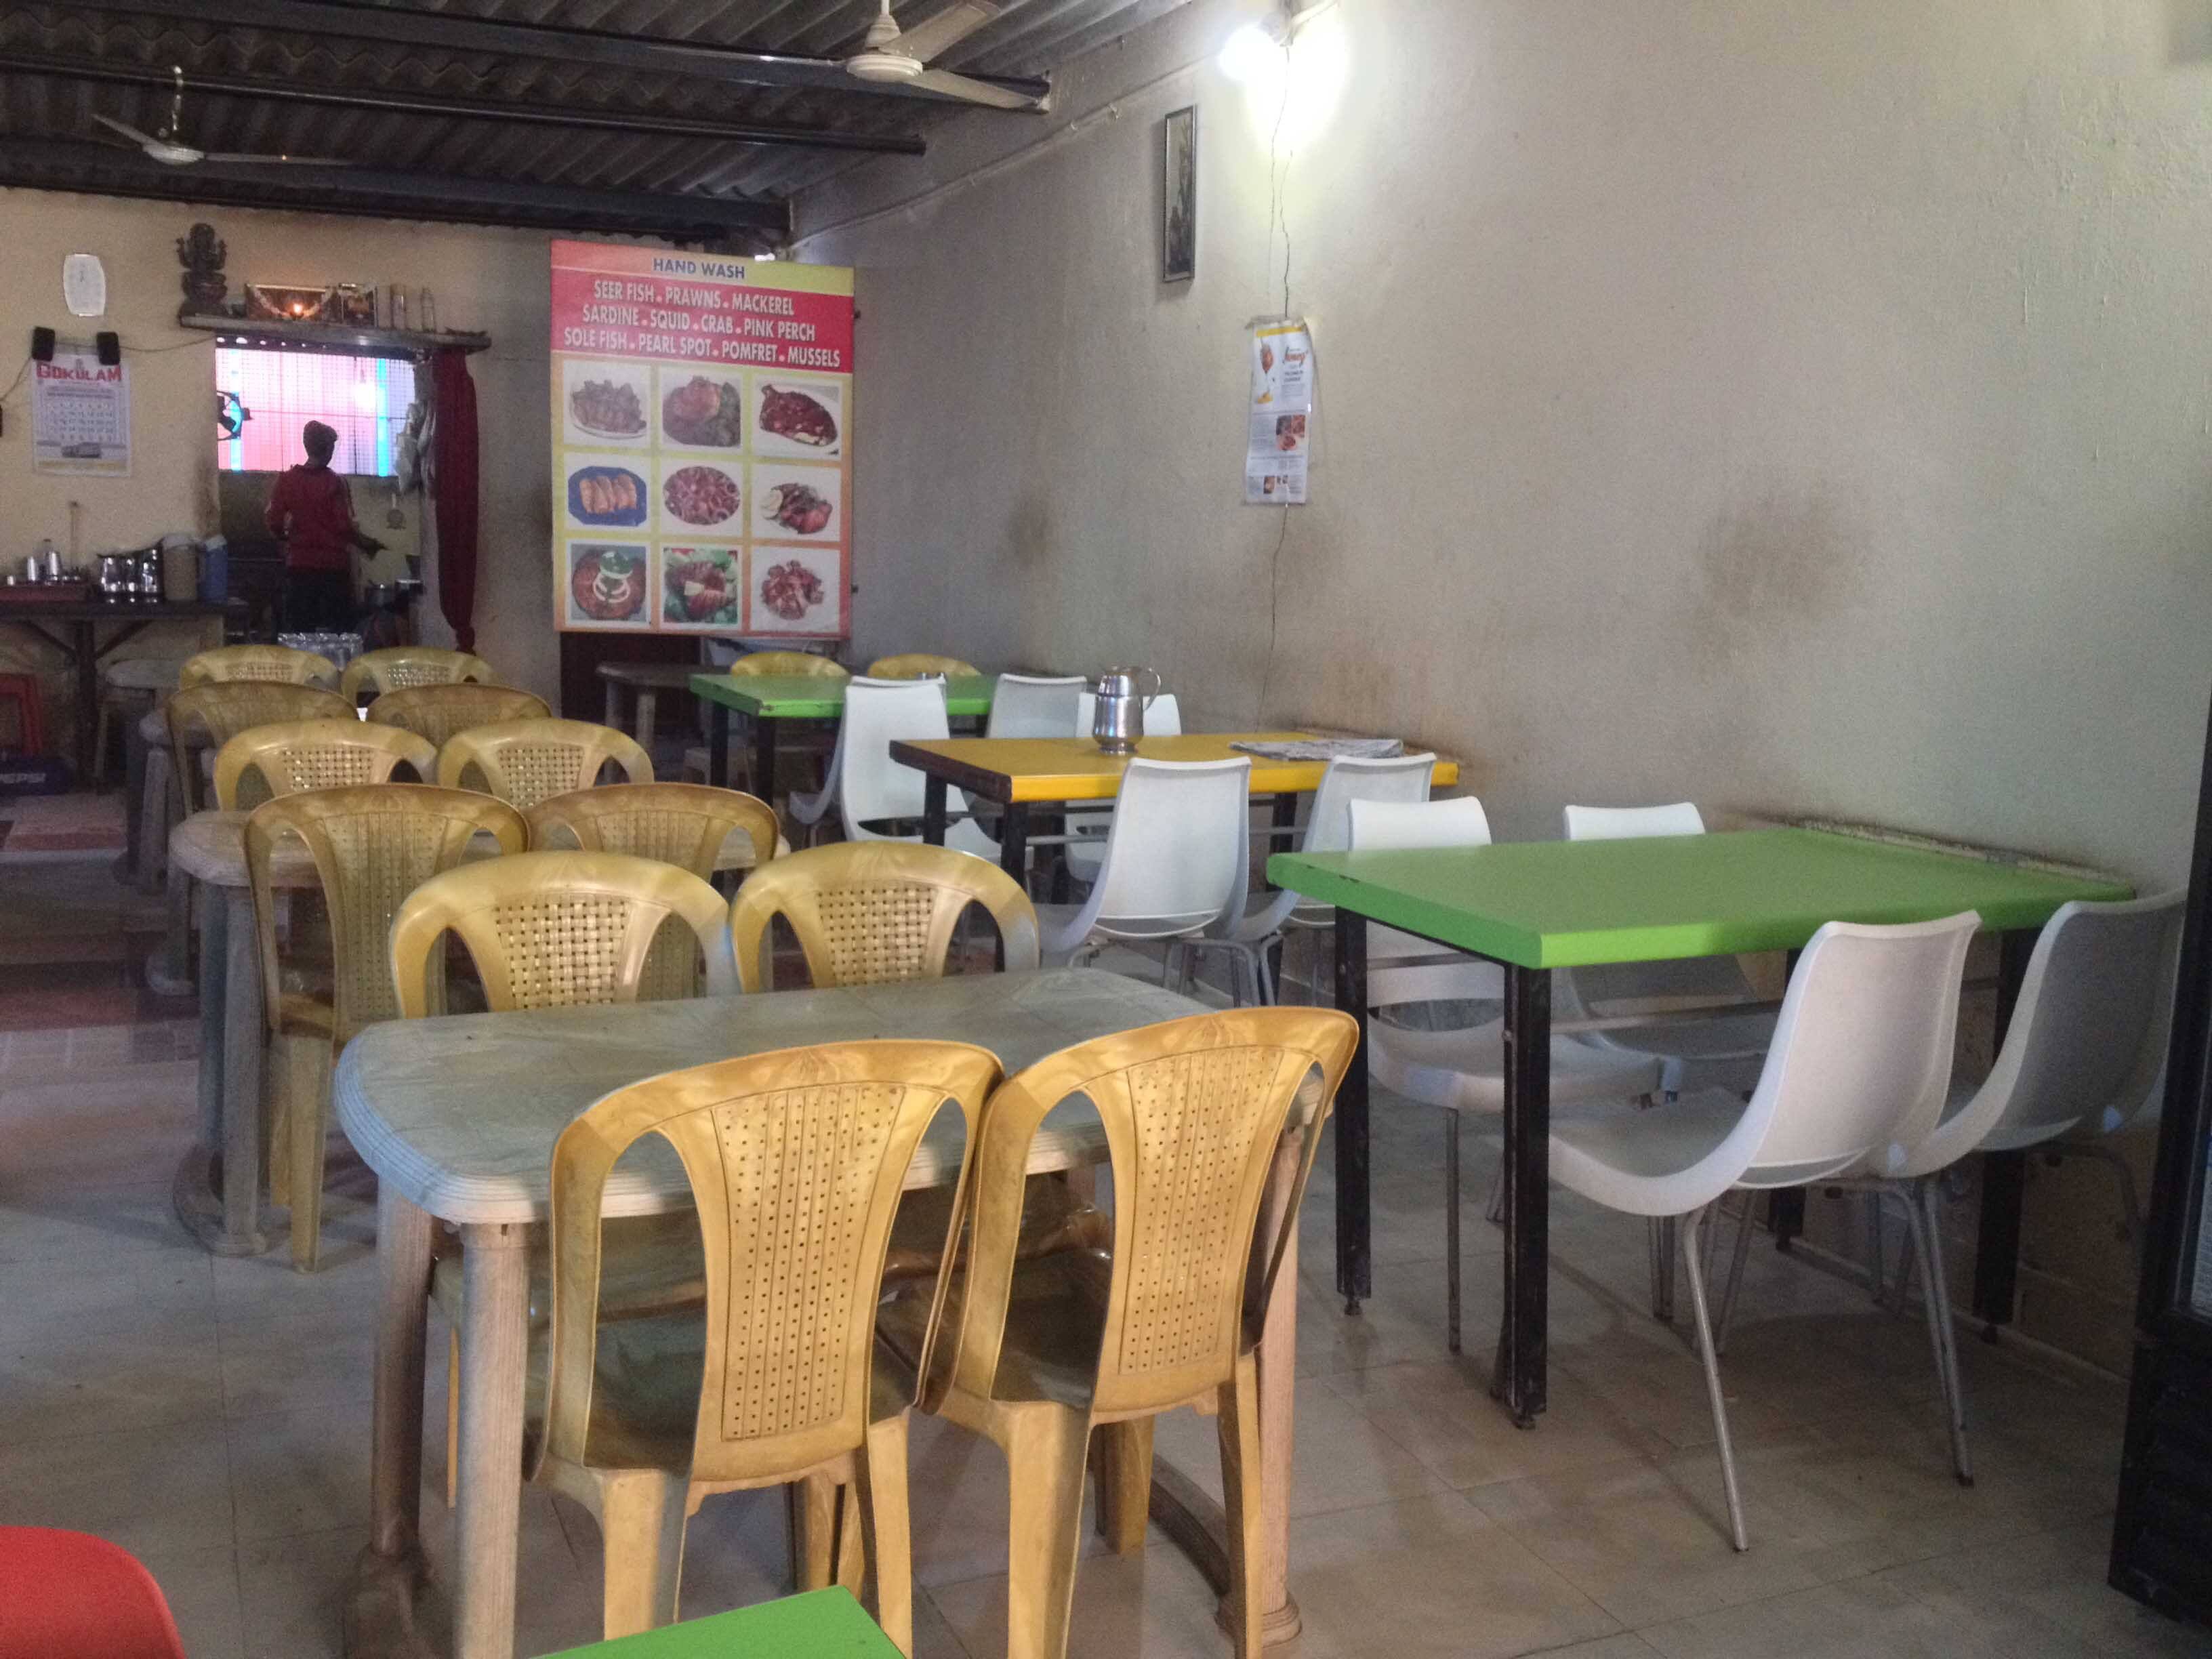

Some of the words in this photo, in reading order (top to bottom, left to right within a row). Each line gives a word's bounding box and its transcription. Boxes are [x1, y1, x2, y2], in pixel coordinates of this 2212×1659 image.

[653, 258, 697, 274] HAND
[701, 263, 745, 279] WASH
[594, 279, 623, 300] SEER
[627, 283, 655, 303] FISH
[665, 286, 721, 308] PRAWNS
[732, 293, 795, 316] MACKEREL
[582, 304, 640, 326] SARDINE
[650, 309, 691, 331] SQUID
[701, 314, 734, 334] CRAB
[744, 318, 775, 338] PINK
[778, 321, 816, 342] PERCH
[564, 327, 596, 348] SOLE
[599, 329, 628, 350] FISH
[638, 333, 676, 354] PEARL
[680, 337, 712, 358] SPOT
[722, 340, 778, 363] POMFRET
[787, 345, 841, 368] MUSSELS
